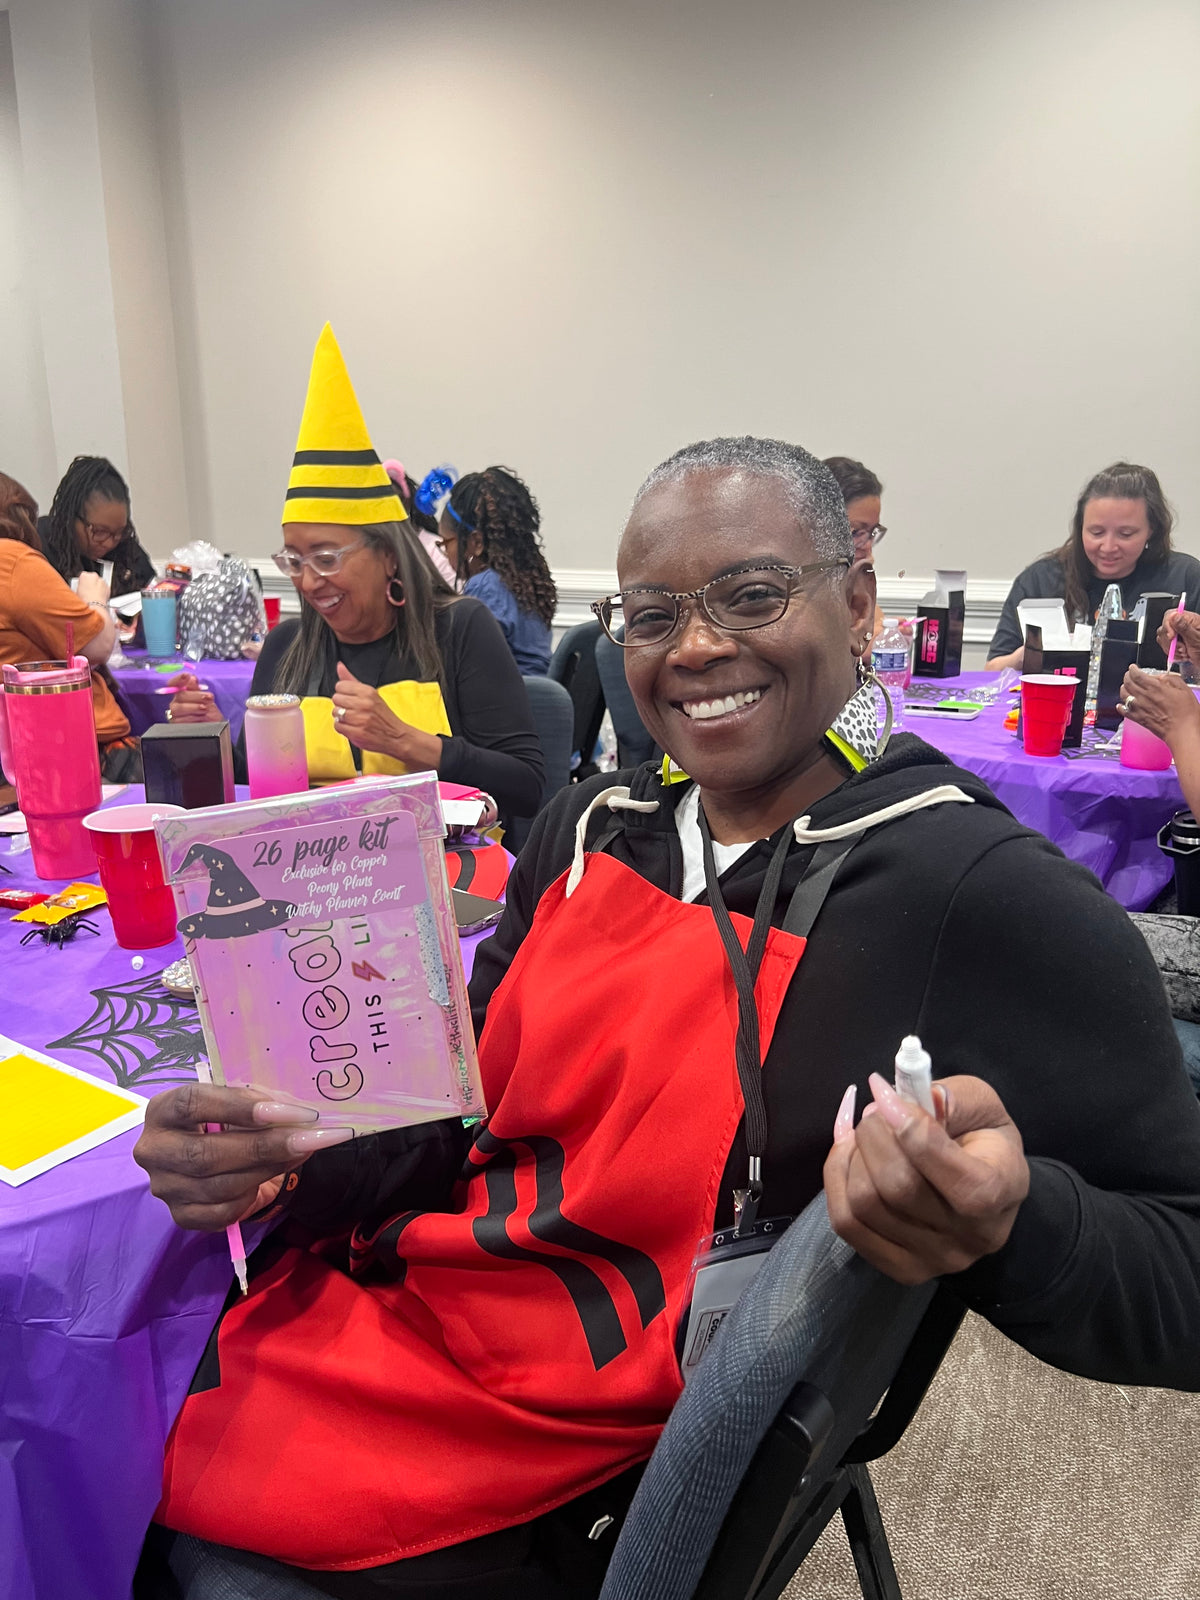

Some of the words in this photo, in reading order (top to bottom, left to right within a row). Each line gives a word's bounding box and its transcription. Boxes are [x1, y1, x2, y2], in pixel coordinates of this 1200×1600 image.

[252, 839, 283, 868] 26
[292, 835, 351, 873] page
[358, 816, 400, 851] kit
[281, 863, 329, 884] Exclusive
[331, 859, 347, 876] for
[350, 854, 388, 873] Copper
[307, 881, 340, 898] Peony
[343, 874, 374, 891] Plans
[285, 900, 323, 919] Witchy
[325, 894, 369, 913] Planner
[372, 885, 406, 905] Event
[365, 994, 389, 1053] THIS
